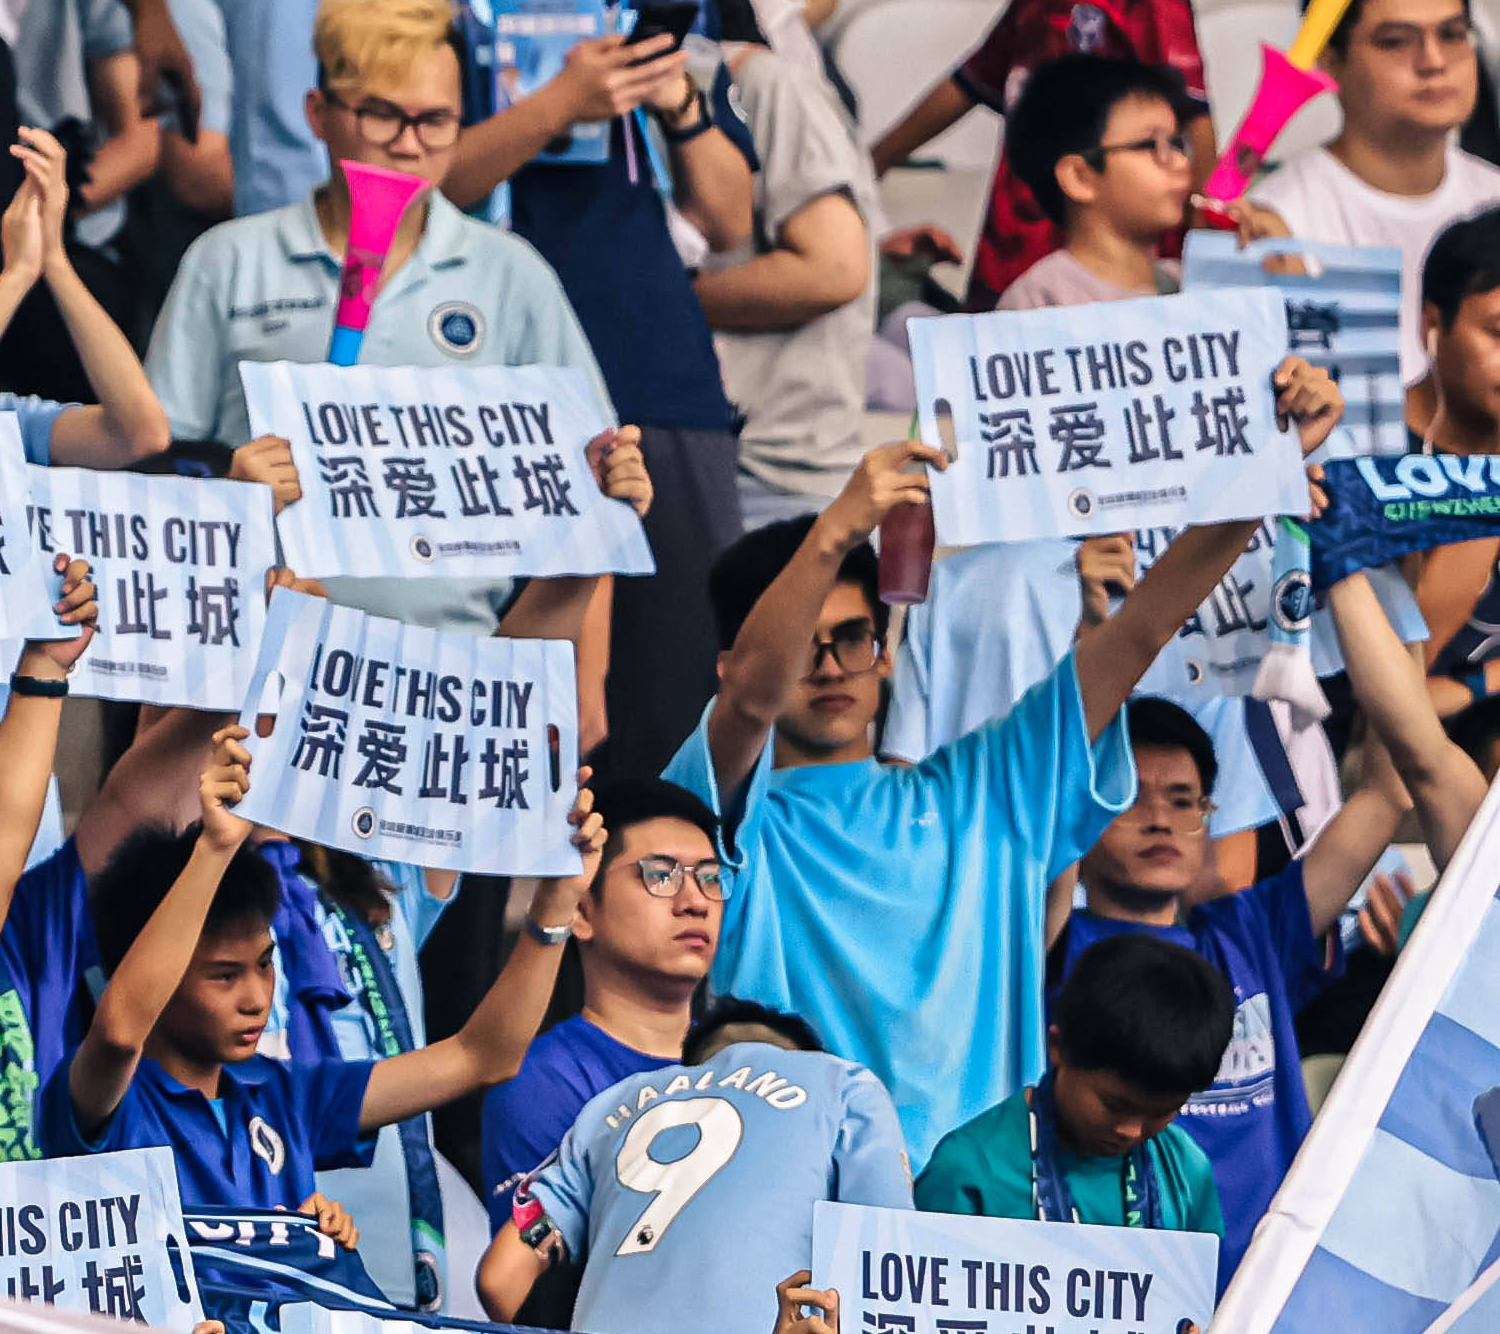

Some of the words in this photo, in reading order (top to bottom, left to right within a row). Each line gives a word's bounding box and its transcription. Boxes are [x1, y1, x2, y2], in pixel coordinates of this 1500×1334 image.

[969, 348, 1061, 402] LOVE
[1065, 341, 1153, 393] THIS
[1163, 331, 1239, 383] CITY
[978, 386, 1253, 480] 深爱此城
[1355, 453, 1500, 501] LOV
[290, 699, 529, 812] 深爱此城
[604, 1066, 808, 1130] HAALAND
[613, 1096, 743, 1257] 9
[862, 1251, 949, 1306] LOVE
[962, 1260, 1050, 1314] THIS
[1067, 1268, 1153, 1322] CITY
